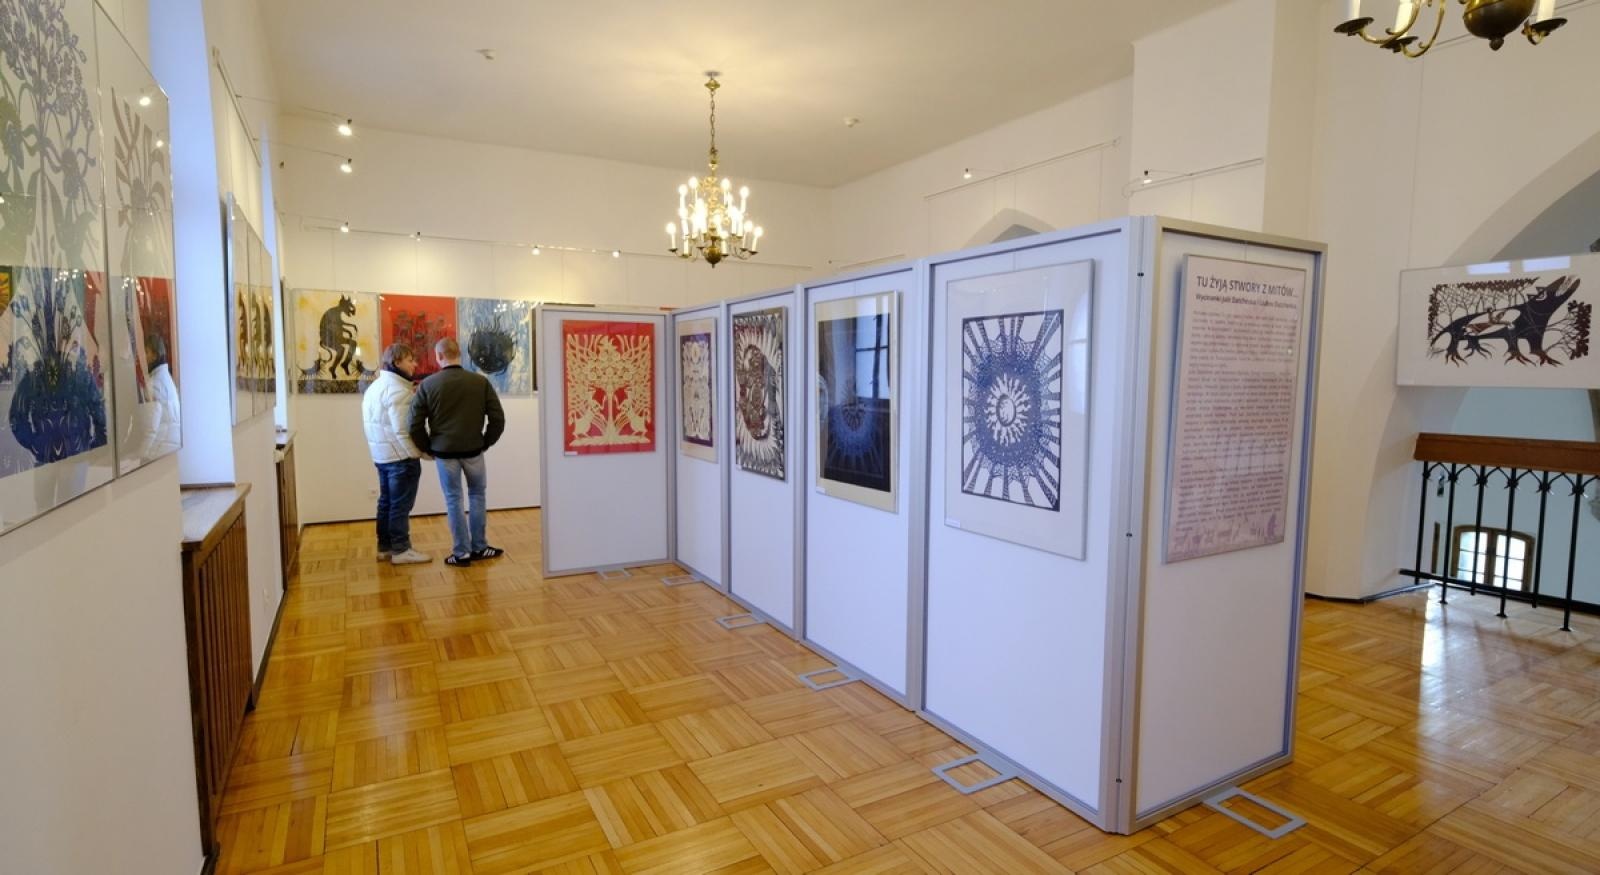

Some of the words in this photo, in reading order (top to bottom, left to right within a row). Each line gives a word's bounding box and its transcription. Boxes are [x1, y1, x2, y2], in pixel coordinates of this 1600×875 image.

[1197, 276, 1209, 288] TU
[1210, 274, 1228, 292] ŻYJĄ
[1229, 280, 1260, 293] STWORY
[1262, 284, 1267, 294] Z
